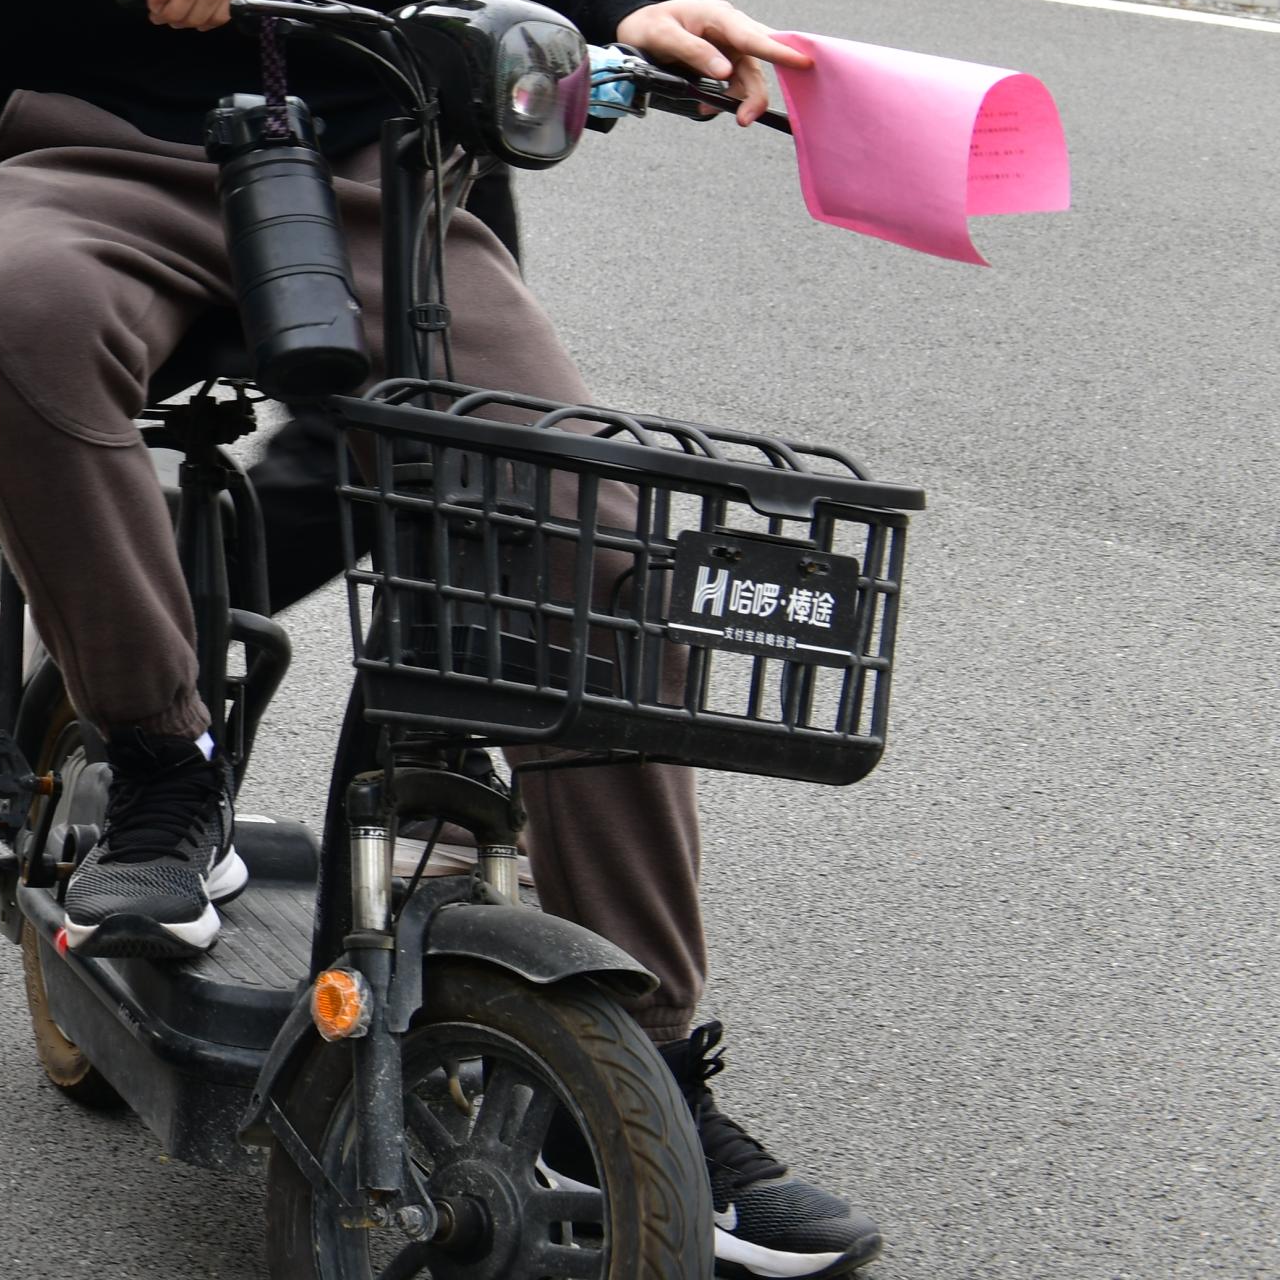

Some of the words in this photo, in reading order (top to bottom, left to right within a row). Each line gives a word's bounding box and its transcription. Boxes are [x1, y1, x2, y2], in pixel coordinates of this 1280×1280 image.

[723, 626, 796, 650] 支付宝战略投资
